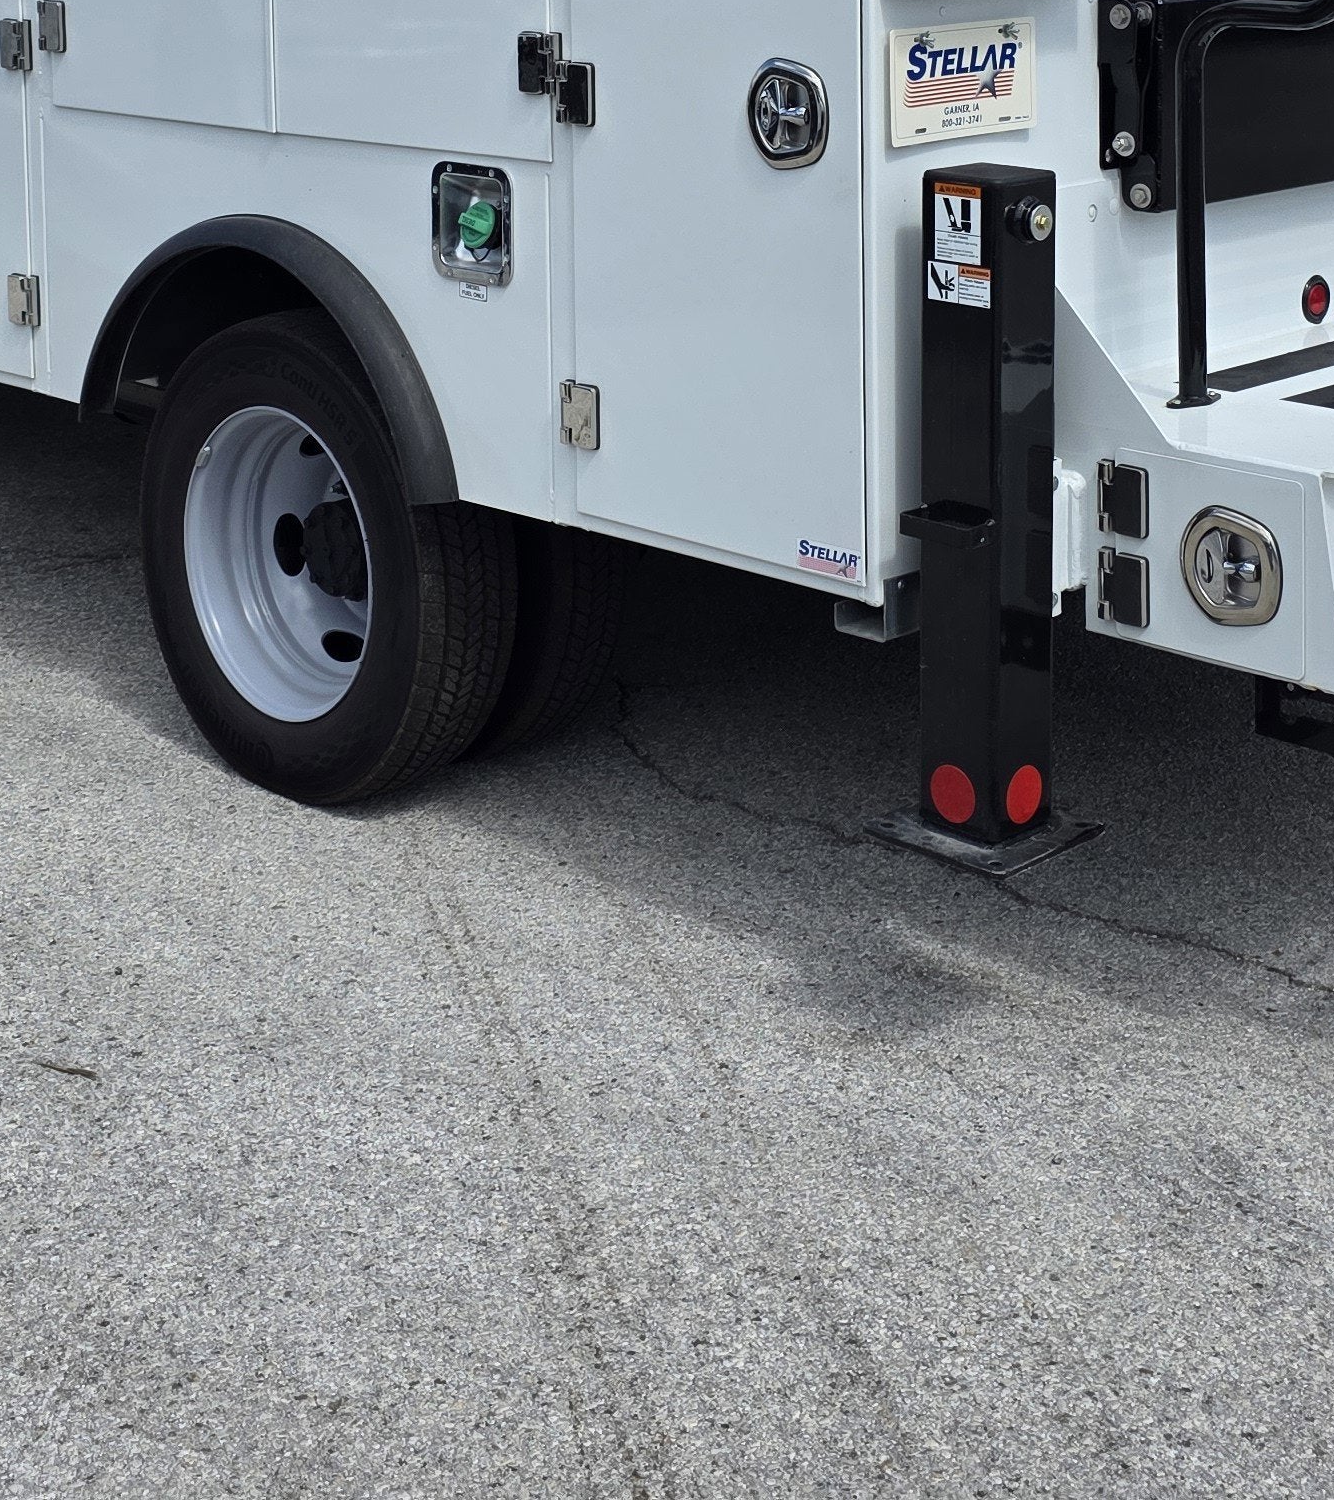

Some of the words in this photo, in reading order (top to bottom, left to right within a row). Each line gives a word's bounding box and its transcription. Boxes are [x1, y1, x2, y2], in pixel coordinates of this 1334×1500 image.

[907, 42, 1017, 81] STELLAR
[946, 186, 977, 195] WARNING
[798, 539, 858, 568] STELLAR
